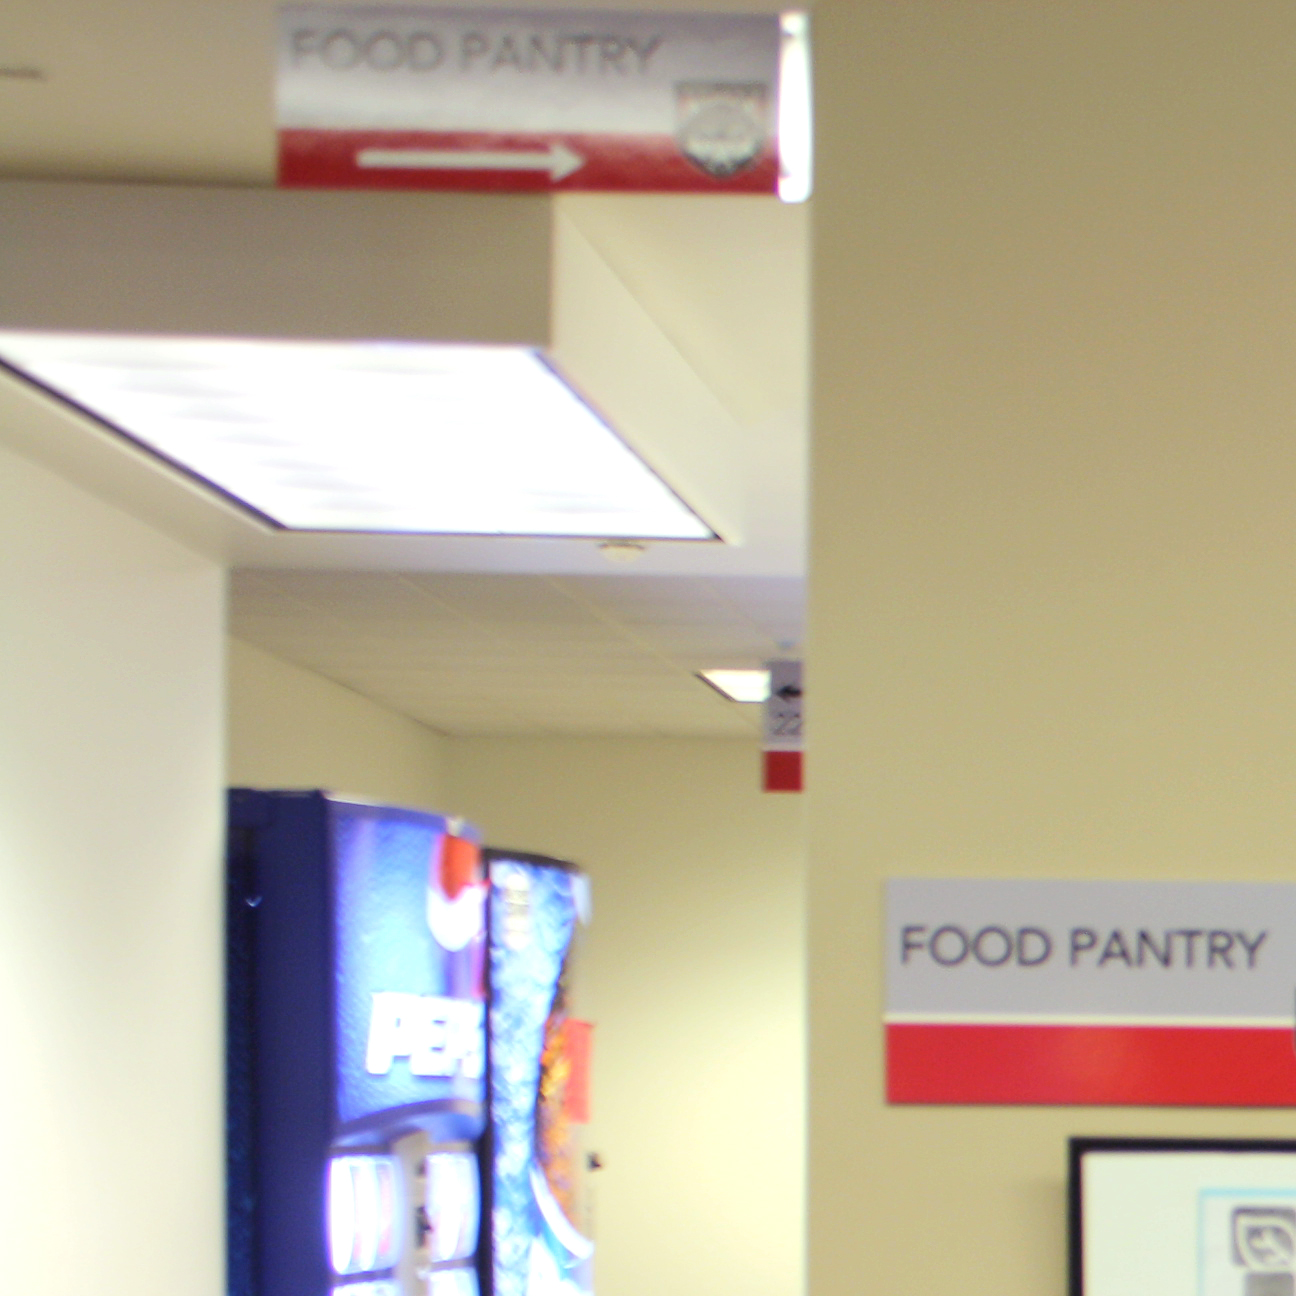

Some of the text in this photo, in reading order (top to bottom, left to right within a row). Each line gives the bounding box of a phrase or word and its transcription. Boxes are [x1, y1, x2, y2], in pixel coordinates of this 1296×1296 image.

[290, 29, 663, 76] FOOD PANTRY
[900, 924, 1269, 970] FOOD PANTRY
